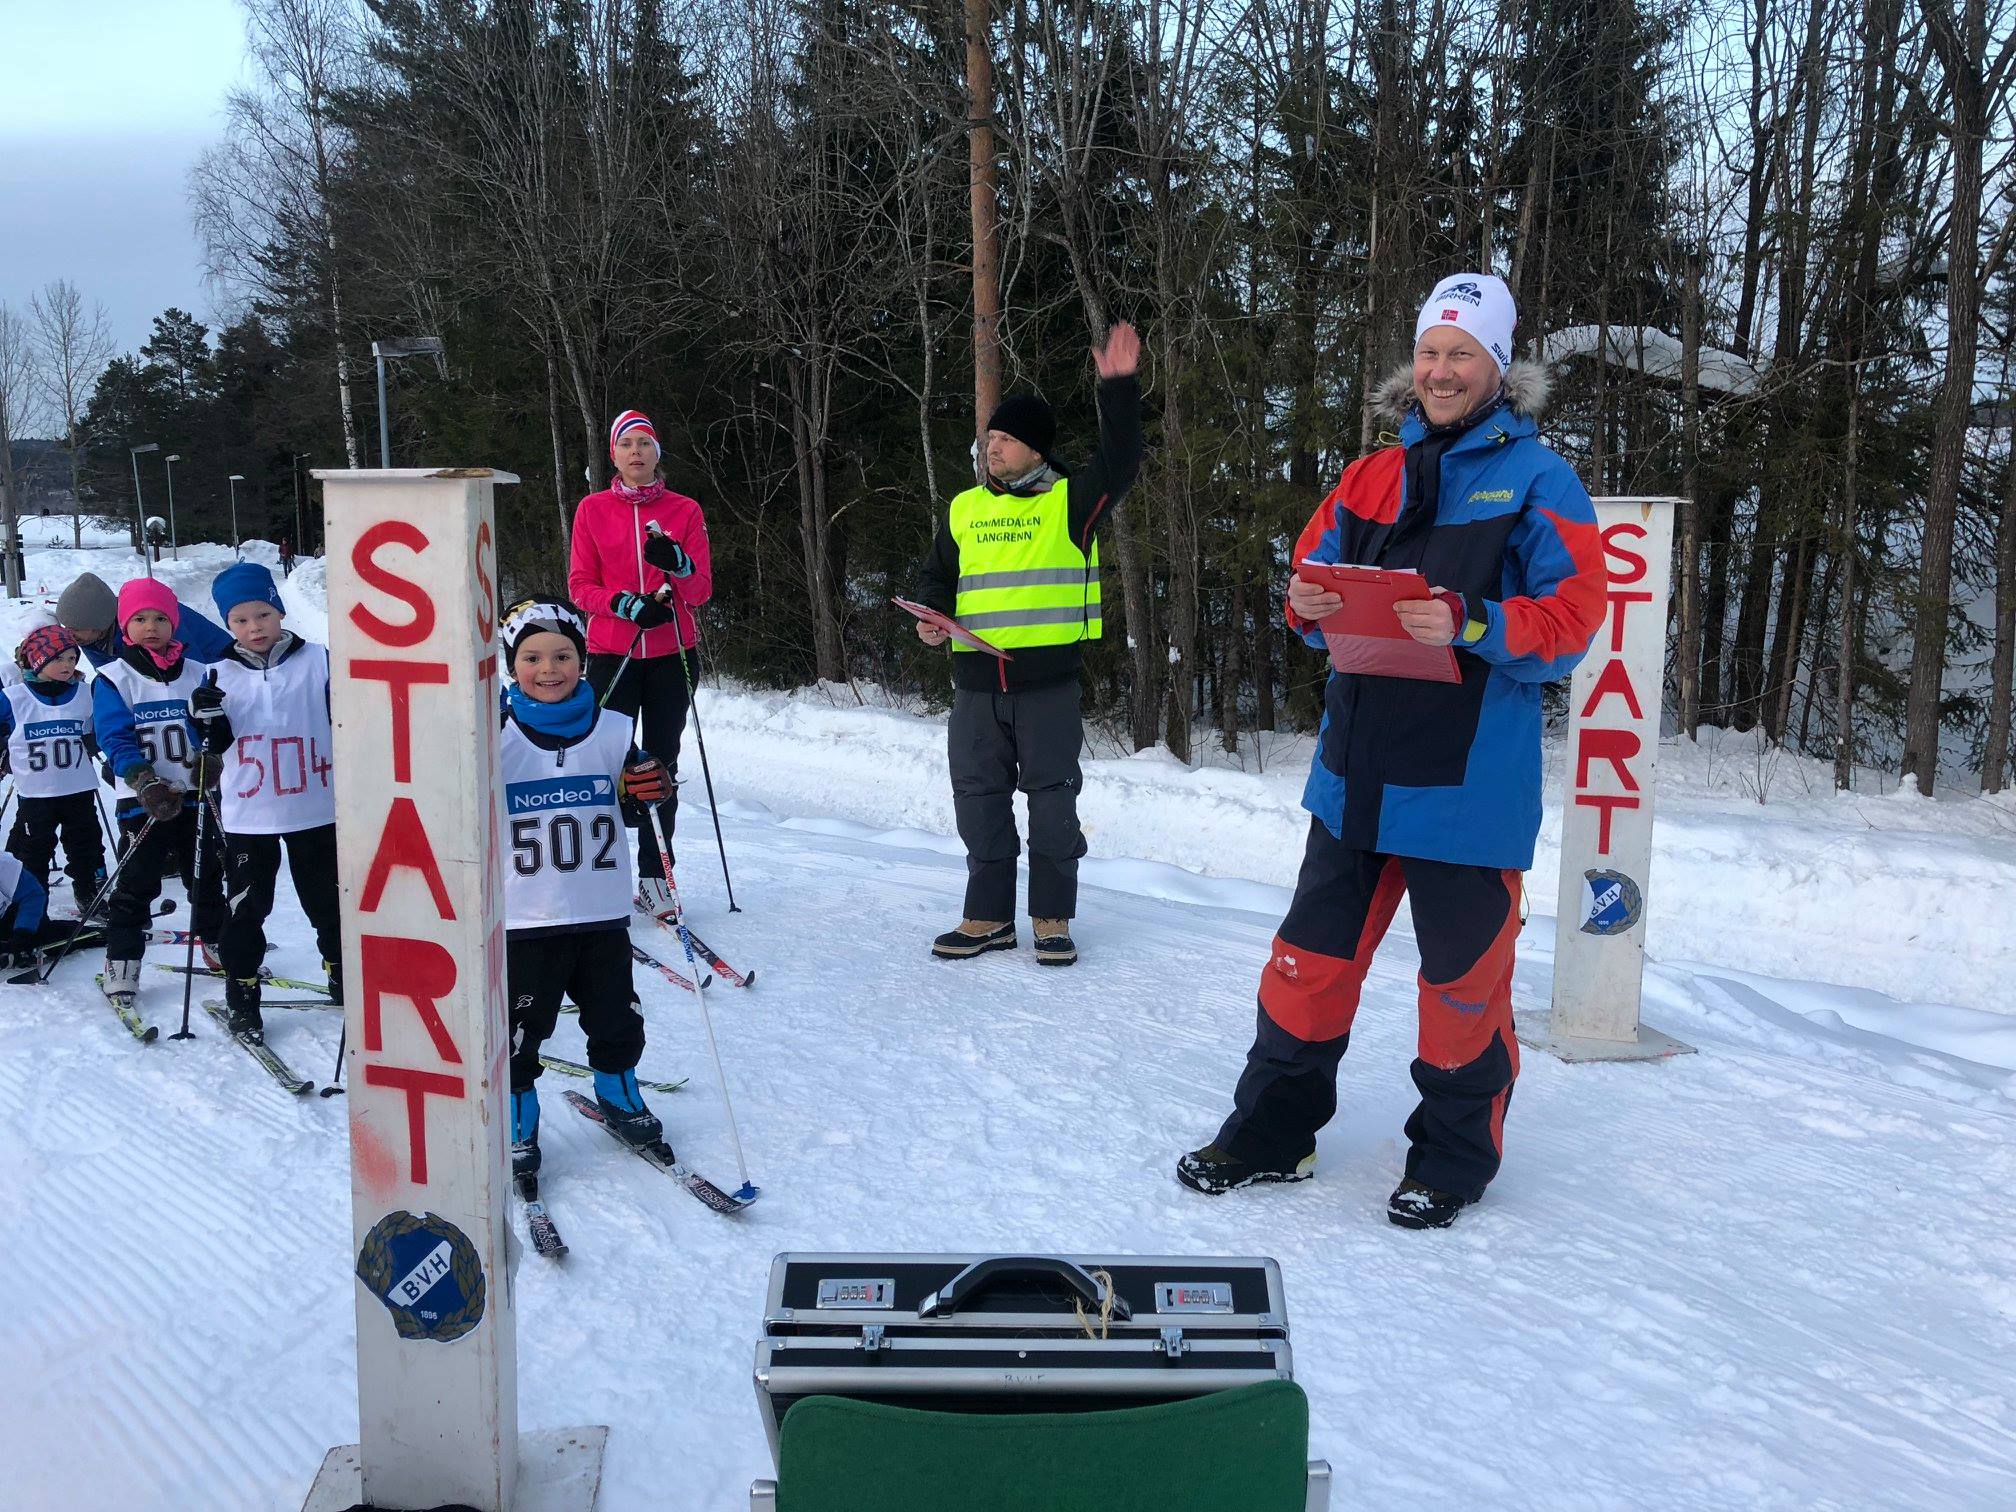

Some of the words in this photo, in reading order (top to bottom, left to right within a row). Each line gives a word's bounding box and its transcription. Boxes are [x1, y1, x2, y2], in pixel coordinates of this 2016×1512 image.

[969, 515, 1041, 529] LOMMEDALEN
[1574, 522, 1652, 855] START
[28, 725, 75, 738] Nordea
[237, 735, 332, 798] 504
[514, 788, 592, 809] Nordea
[348, 520, 465, 1184] START
[510, 813, 618, 877] 502
